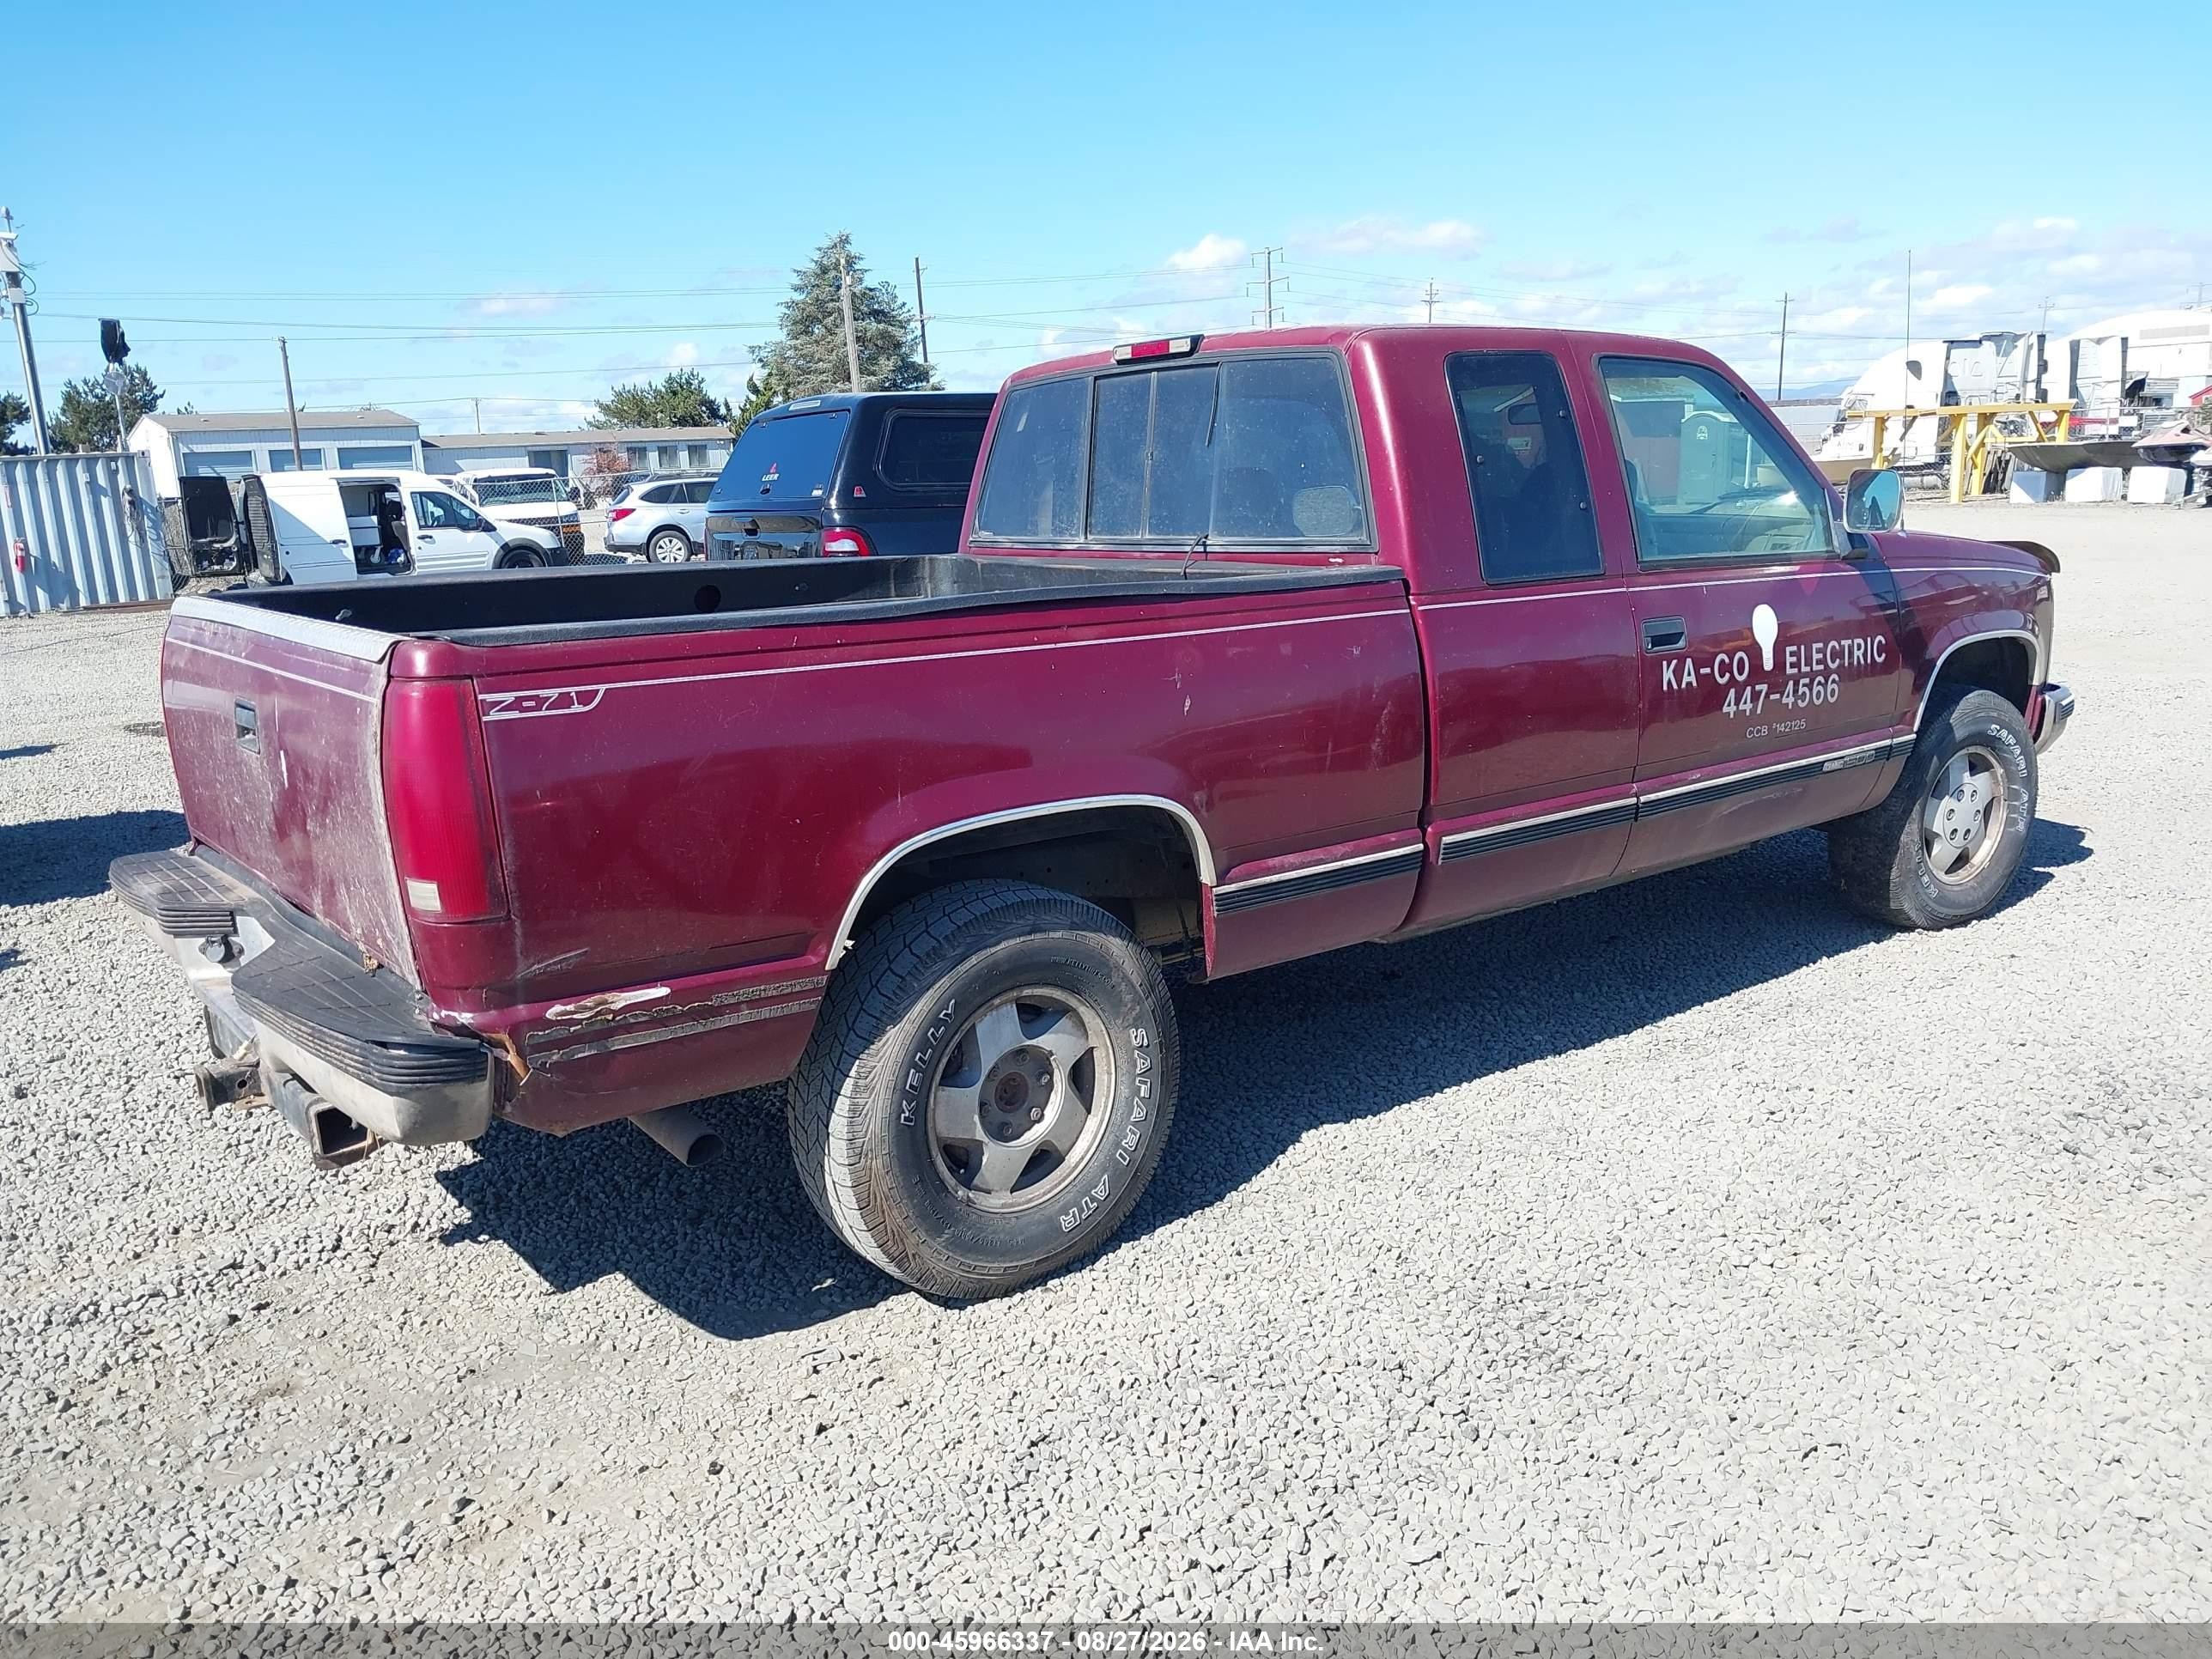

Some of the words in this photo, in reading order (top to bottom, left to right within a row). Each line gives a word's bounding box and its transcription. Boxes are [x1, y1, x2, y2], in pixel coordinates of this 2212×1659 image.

[762, 473, 780, 482] LEER
[1662, 651, 1750, 691] KA-CO
[1785, 635, 1887, 674] ELECTRIC
[486, 691, 584, 716] Z-71
[1723, 673, 1840, 719] 447-4566
[1746, 726, 1769, 738] CCB
[1987, 724, 2028, 778] SAFARI
[900, 999, 956, 1126] KELLY
[1115, 1028, 1152, 1167] SAFARI
[1060, 1175, 1111, 1232] ATR
